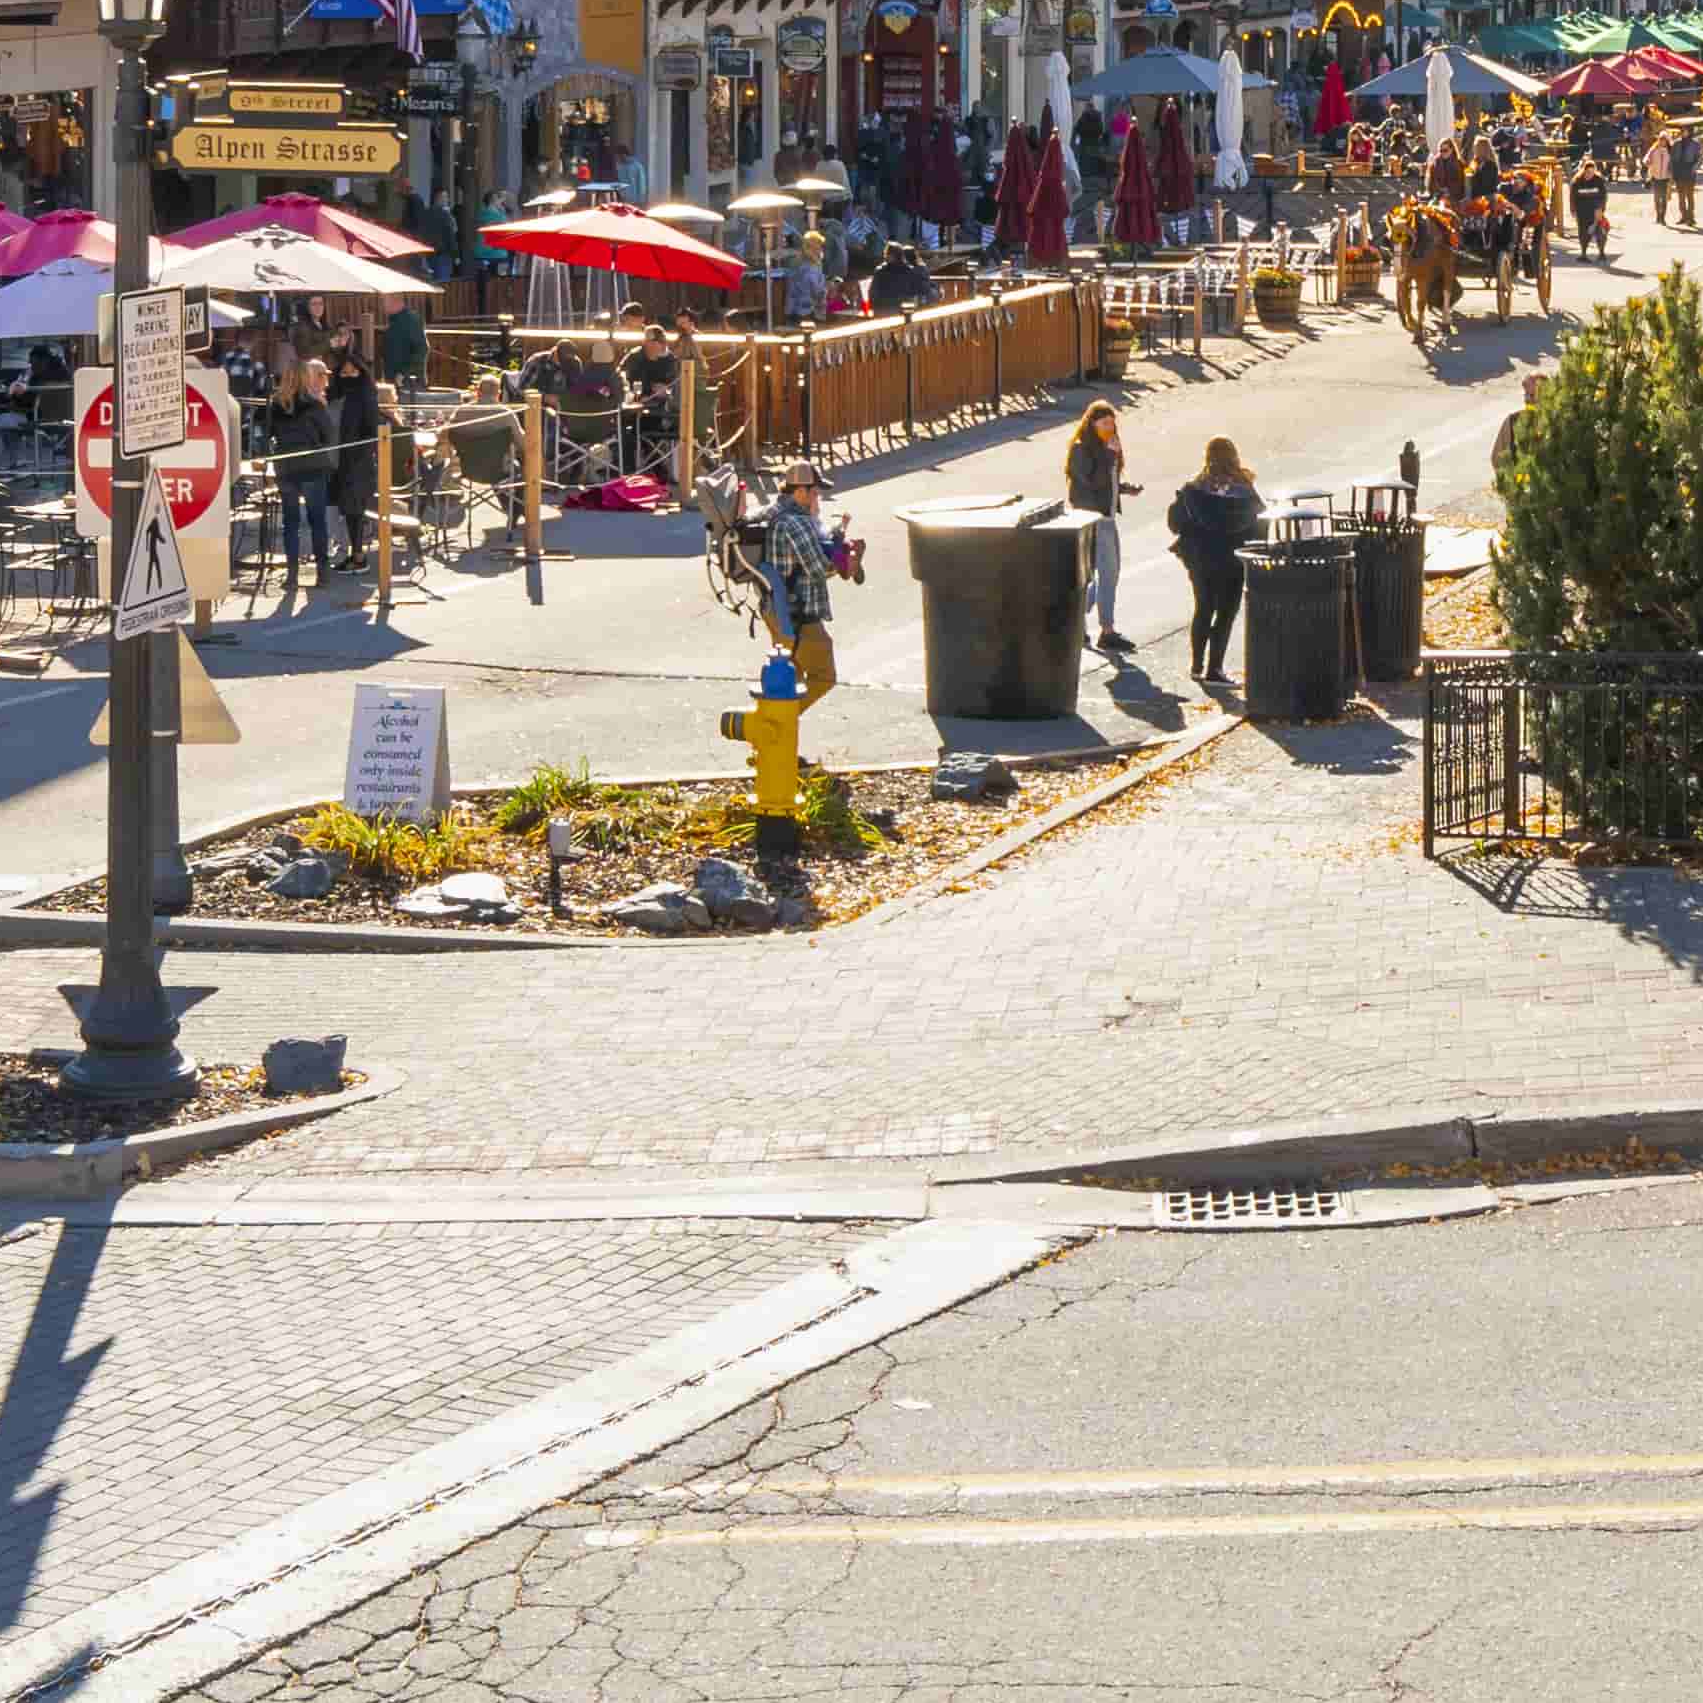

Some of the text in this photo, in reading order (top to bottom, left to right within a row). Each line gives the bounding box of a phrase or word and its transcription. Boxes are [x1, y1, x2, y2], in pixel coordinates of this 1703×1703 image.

[271, 95, 331, 110] Street
[195, 134, 378, 163] Alpen Strasse
[186, 305, 202, 331] AY
[134, 319, 170, 336] PARKING
[100, 402, 113, 425] D
[372, 714, 420, 729] Alcohol
[376, 731, 413, 743] can be
[363, 747, 422, 759] consumed
[360, 763, 422, 780] only inside
[355, 782, 421, 794] restaurants
